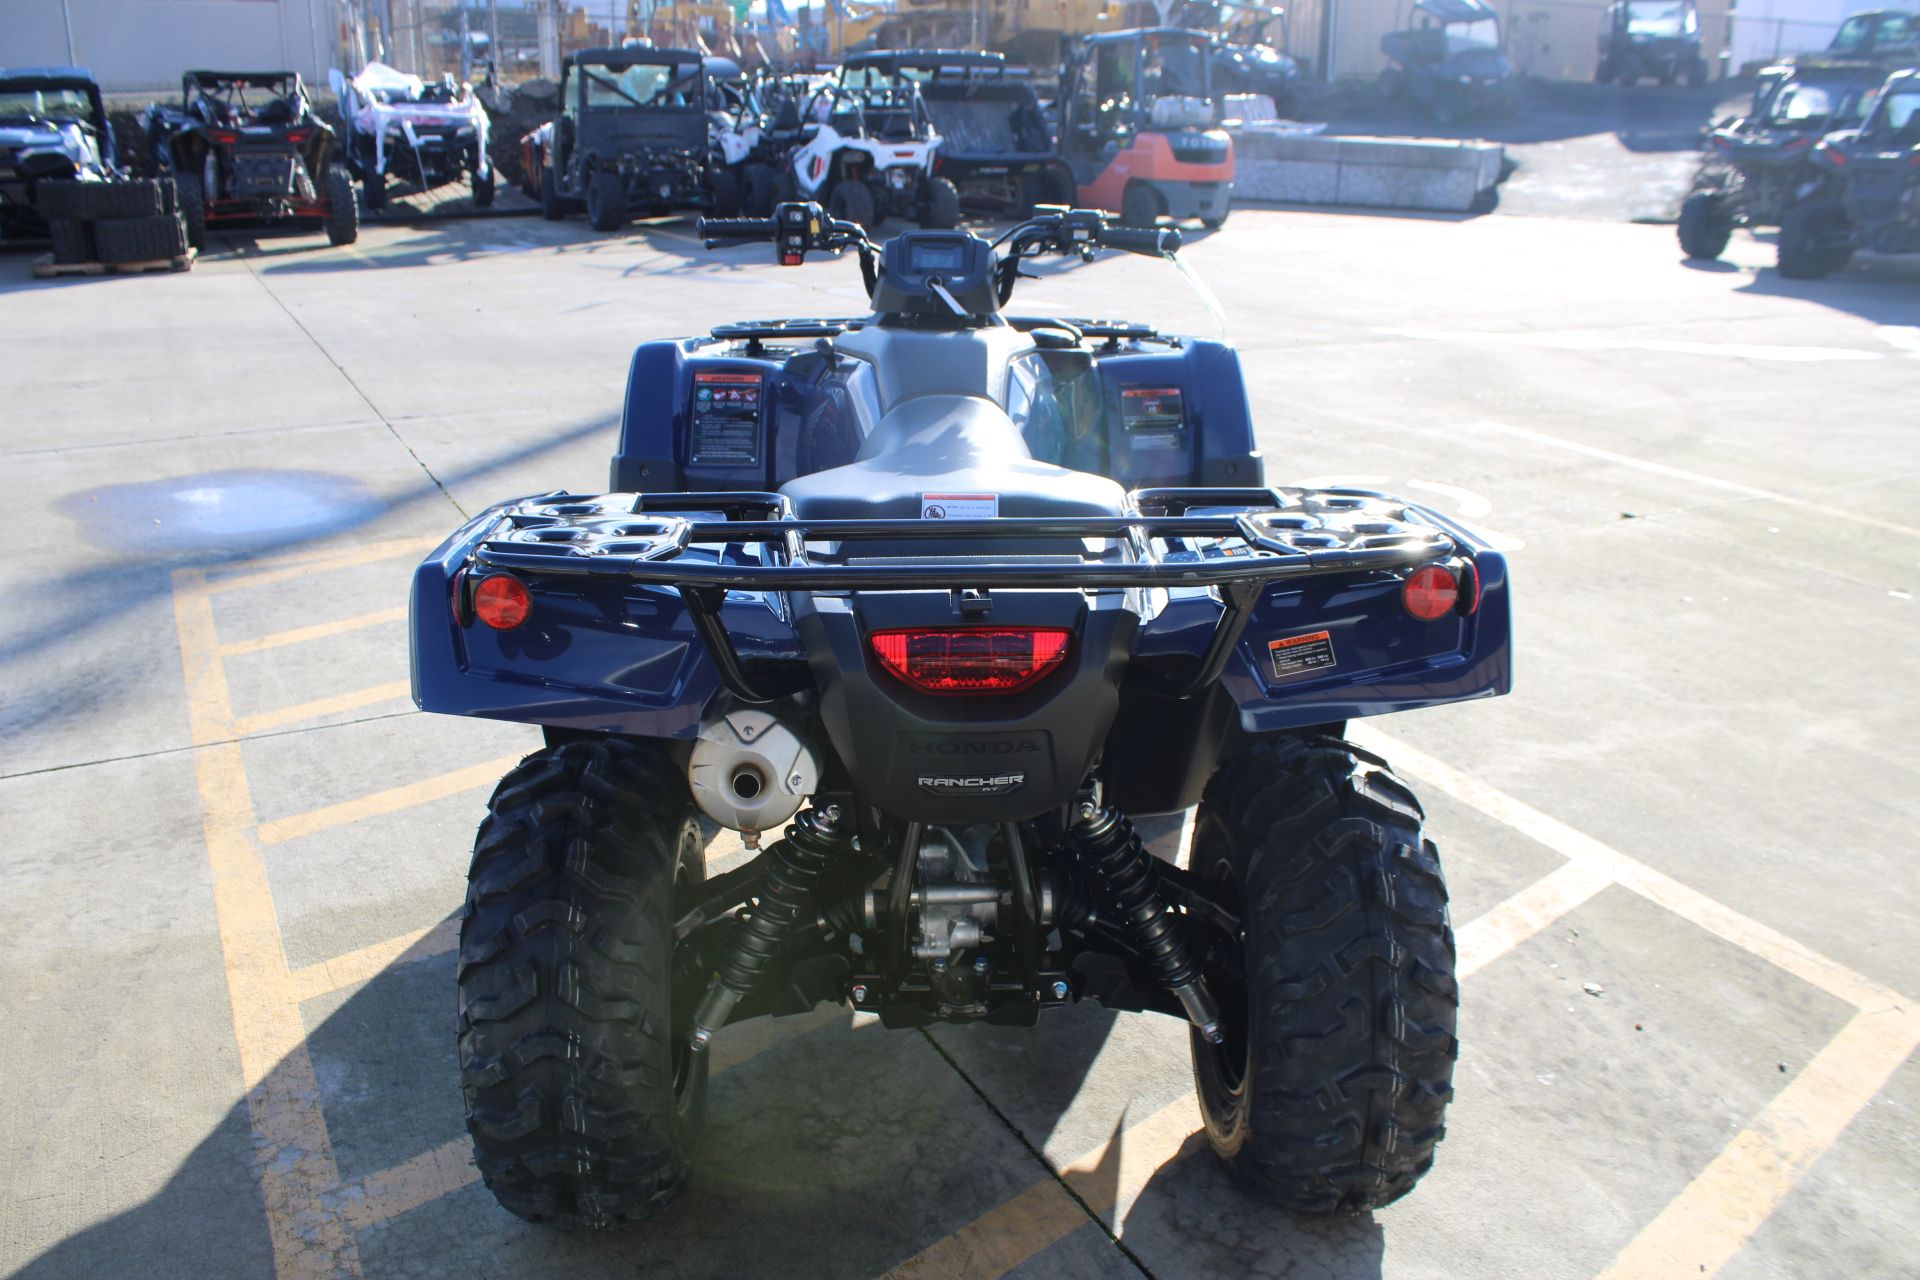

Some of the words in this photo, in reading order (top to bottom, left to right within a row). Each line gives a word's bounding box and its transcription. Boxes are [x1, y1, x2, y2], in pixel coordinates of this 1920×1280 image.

[1286, 634, 1319, 646] WARNING
[909, 741, 1042, 754] HONDA
[918, 775, 1024, 786] RANCHER
